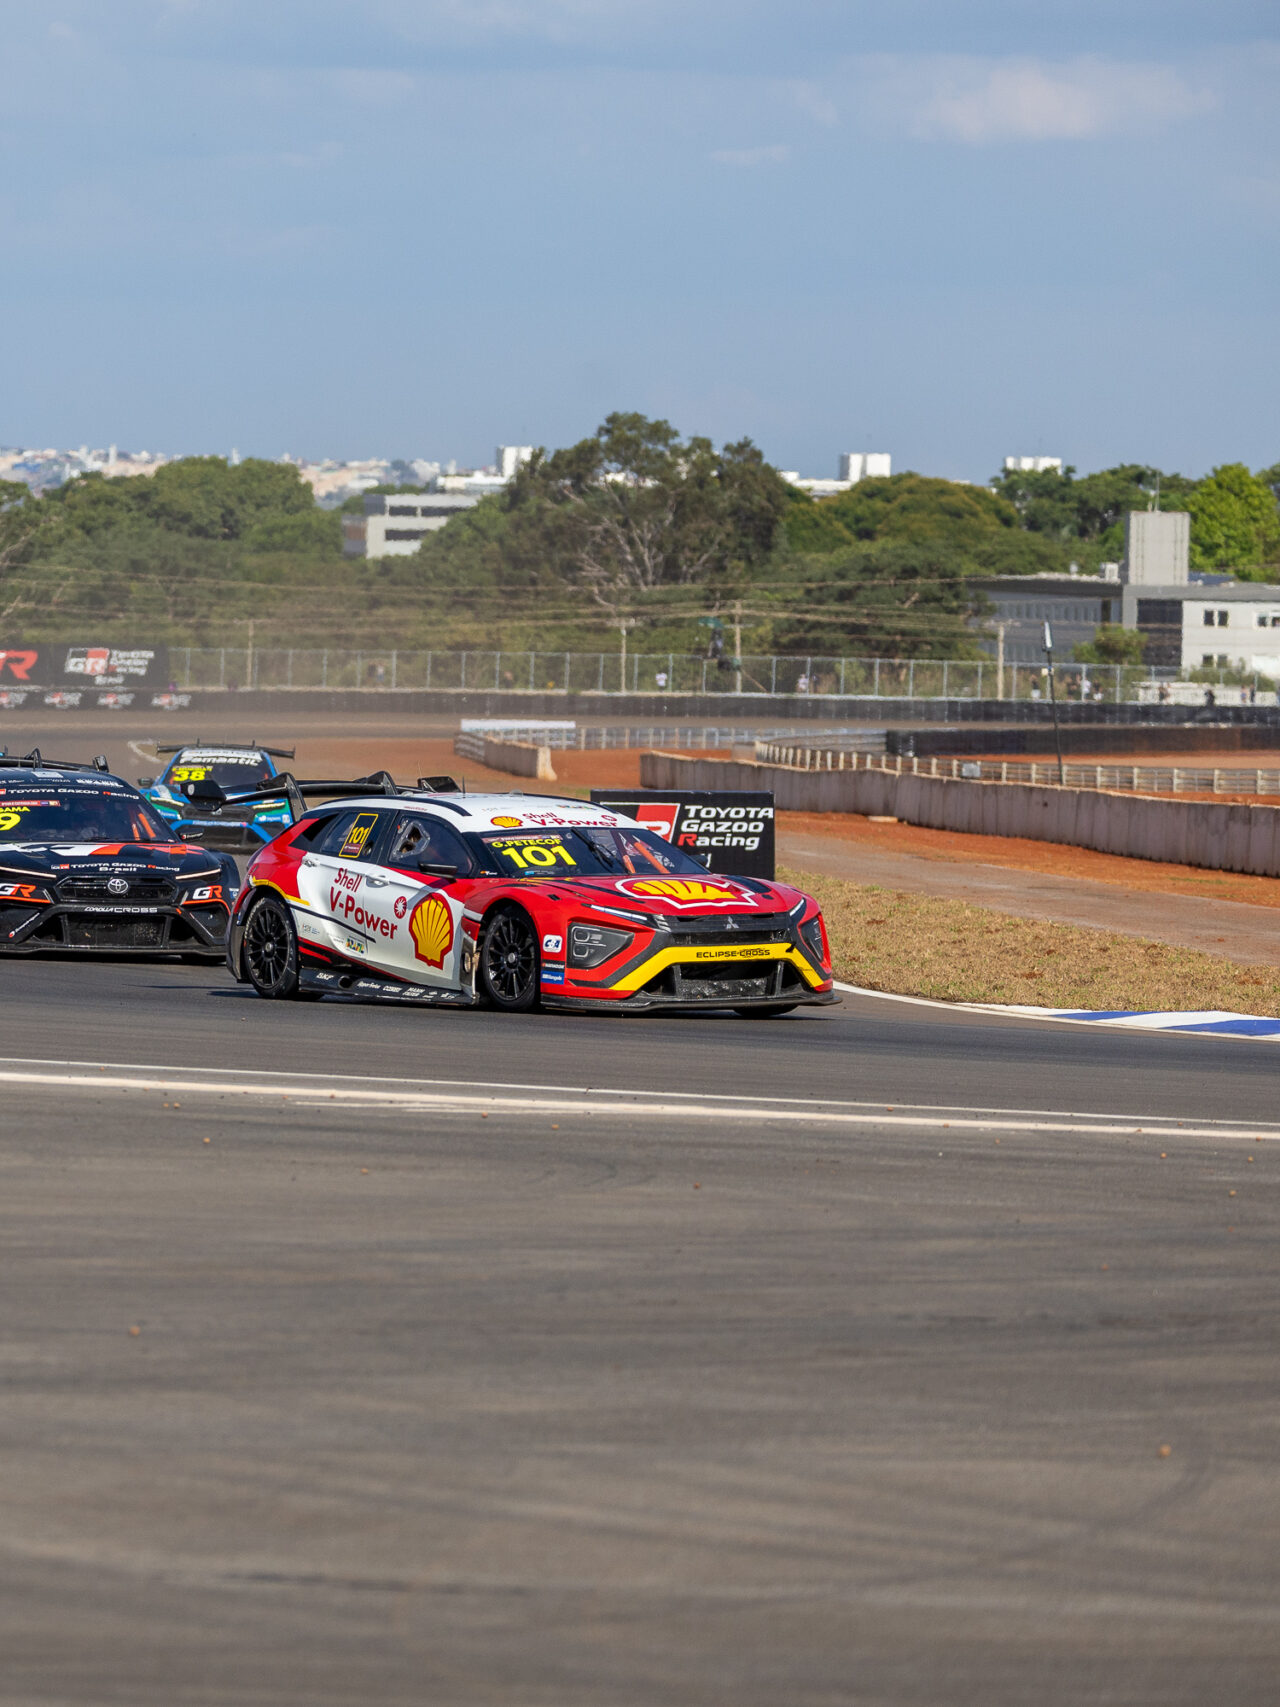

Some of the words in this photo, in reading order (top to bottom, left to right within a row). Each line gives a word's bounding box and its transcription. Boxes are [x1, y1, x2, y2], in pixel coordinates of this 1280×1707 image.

[173, 770, 206, 781] 38
[102, 791, 140, 800] Racing
[522, 812, 557, 820] Shell
[684, 805, 774, 819] TOYOTA
[530, 818, 618, 827] V-Power
[680, 820, 765, 833] GAZOO
[349, 827, 370, 844] 101
[677, 834, 761, 851] Racing
[501, 845, 577, 868] 101
[147, 864, 180, 872] Racing
[334, 867, 363, 893] Shell
[193, 885, 222, 899] GR
[329, 886, 398, 940] V-Power
[696, 950, 737, 958] ECLIPSE
[739, 949, 770, 957] CROSS
